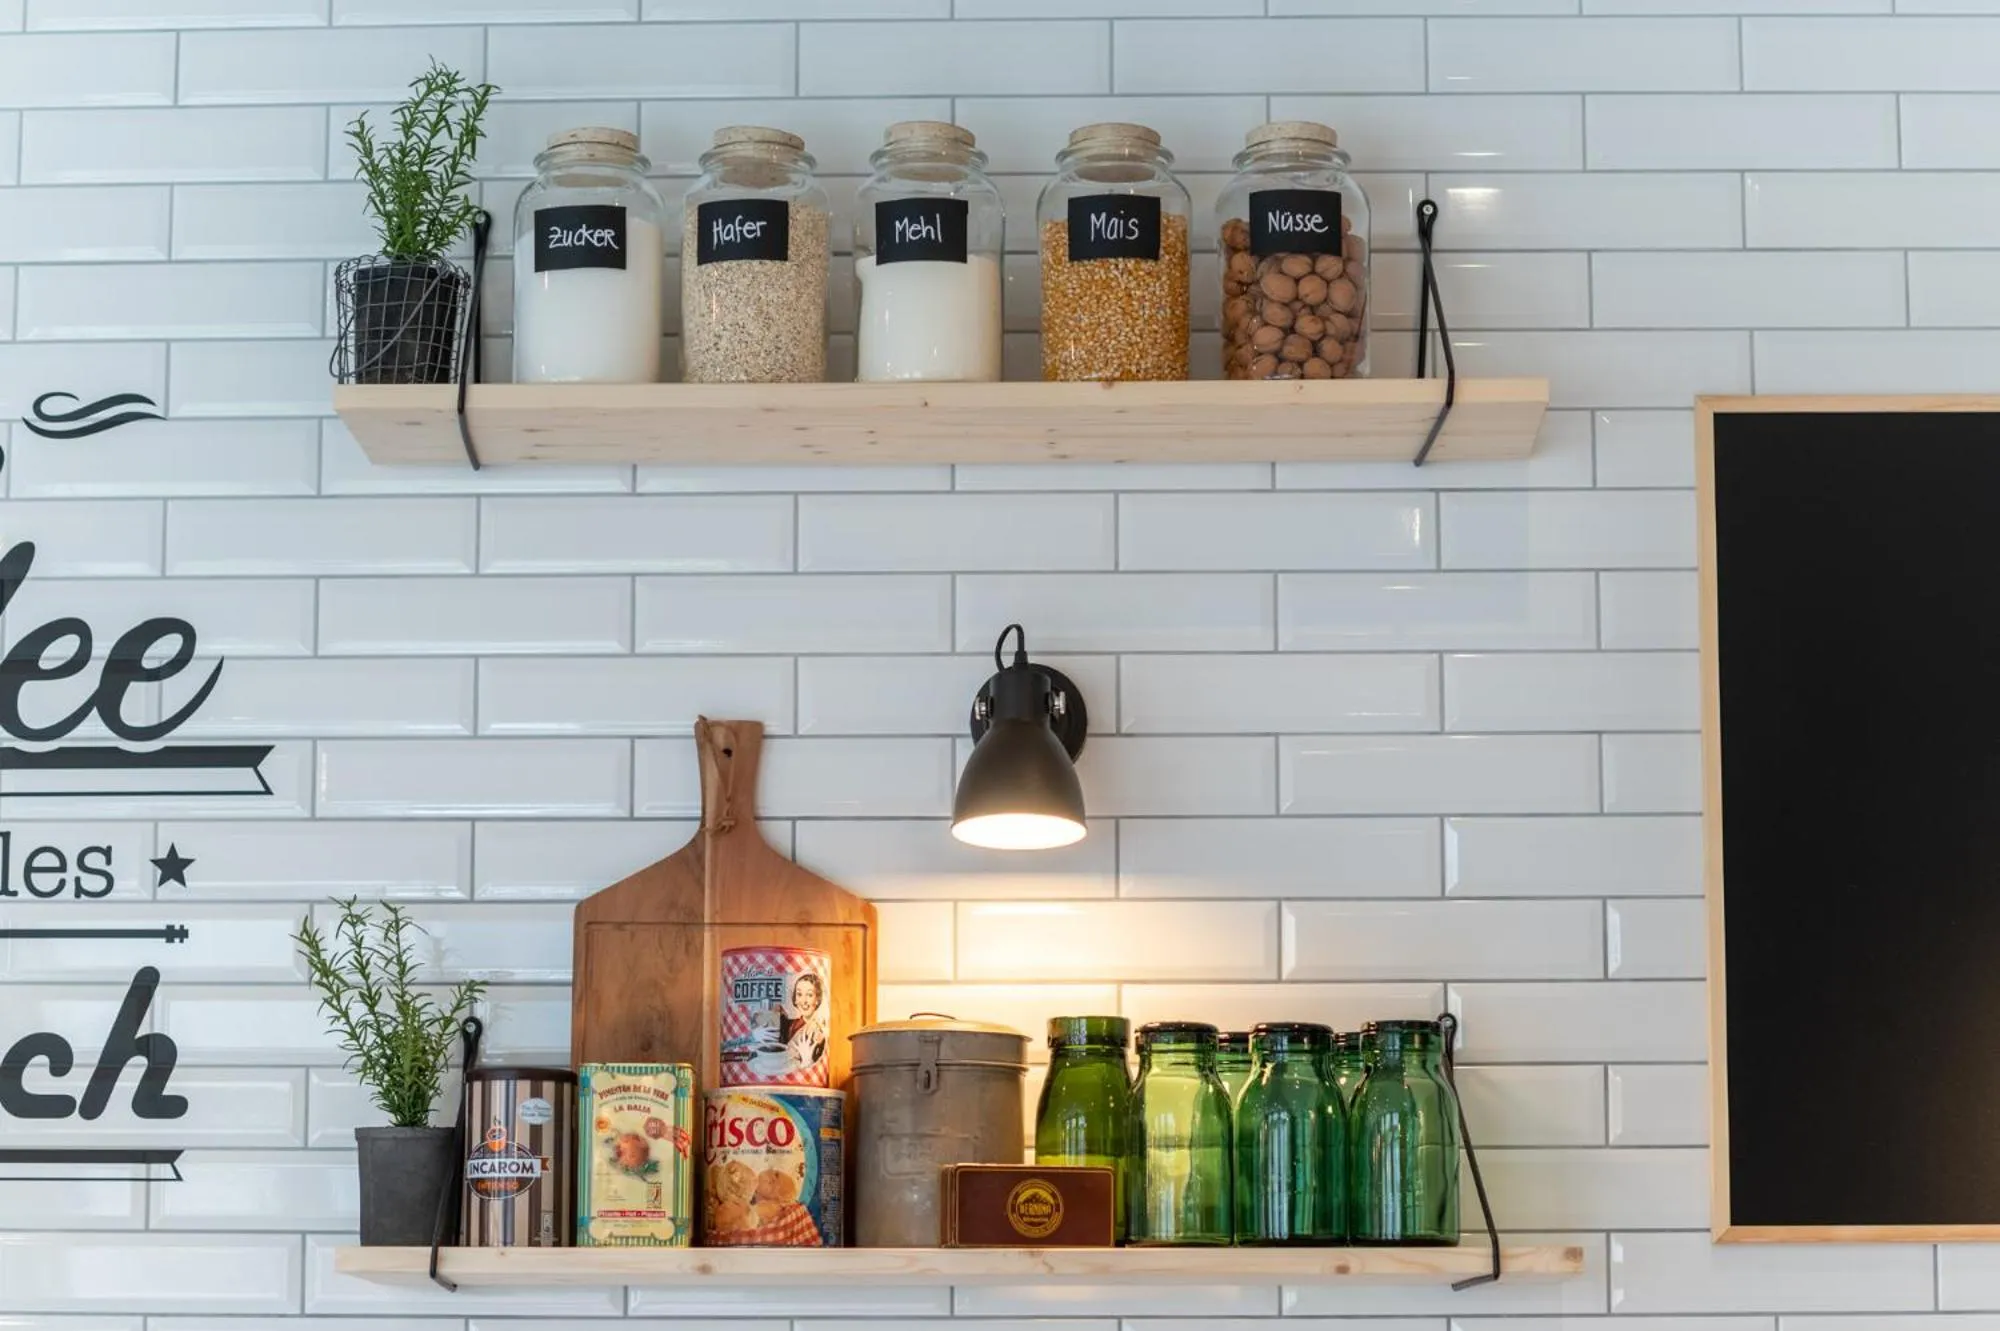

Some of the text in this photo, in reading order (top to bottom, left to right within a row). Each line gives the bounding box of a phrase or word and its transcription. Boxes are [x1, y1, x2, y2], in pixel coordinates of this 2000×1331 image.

[712, 214, 768, 251] Hafer
[894, 212, 943, 244] Mehl
[1090, 210, 1139, 242] Mais
[1267, 209, 1329, 234] Nüsse
[734, 982, 782, 999] COFFEE
[0, 966, 189, 1121] ch
[704, 1104, 795, 1165] Crisco
[470, 1161, 535, 1174] INCAROM
